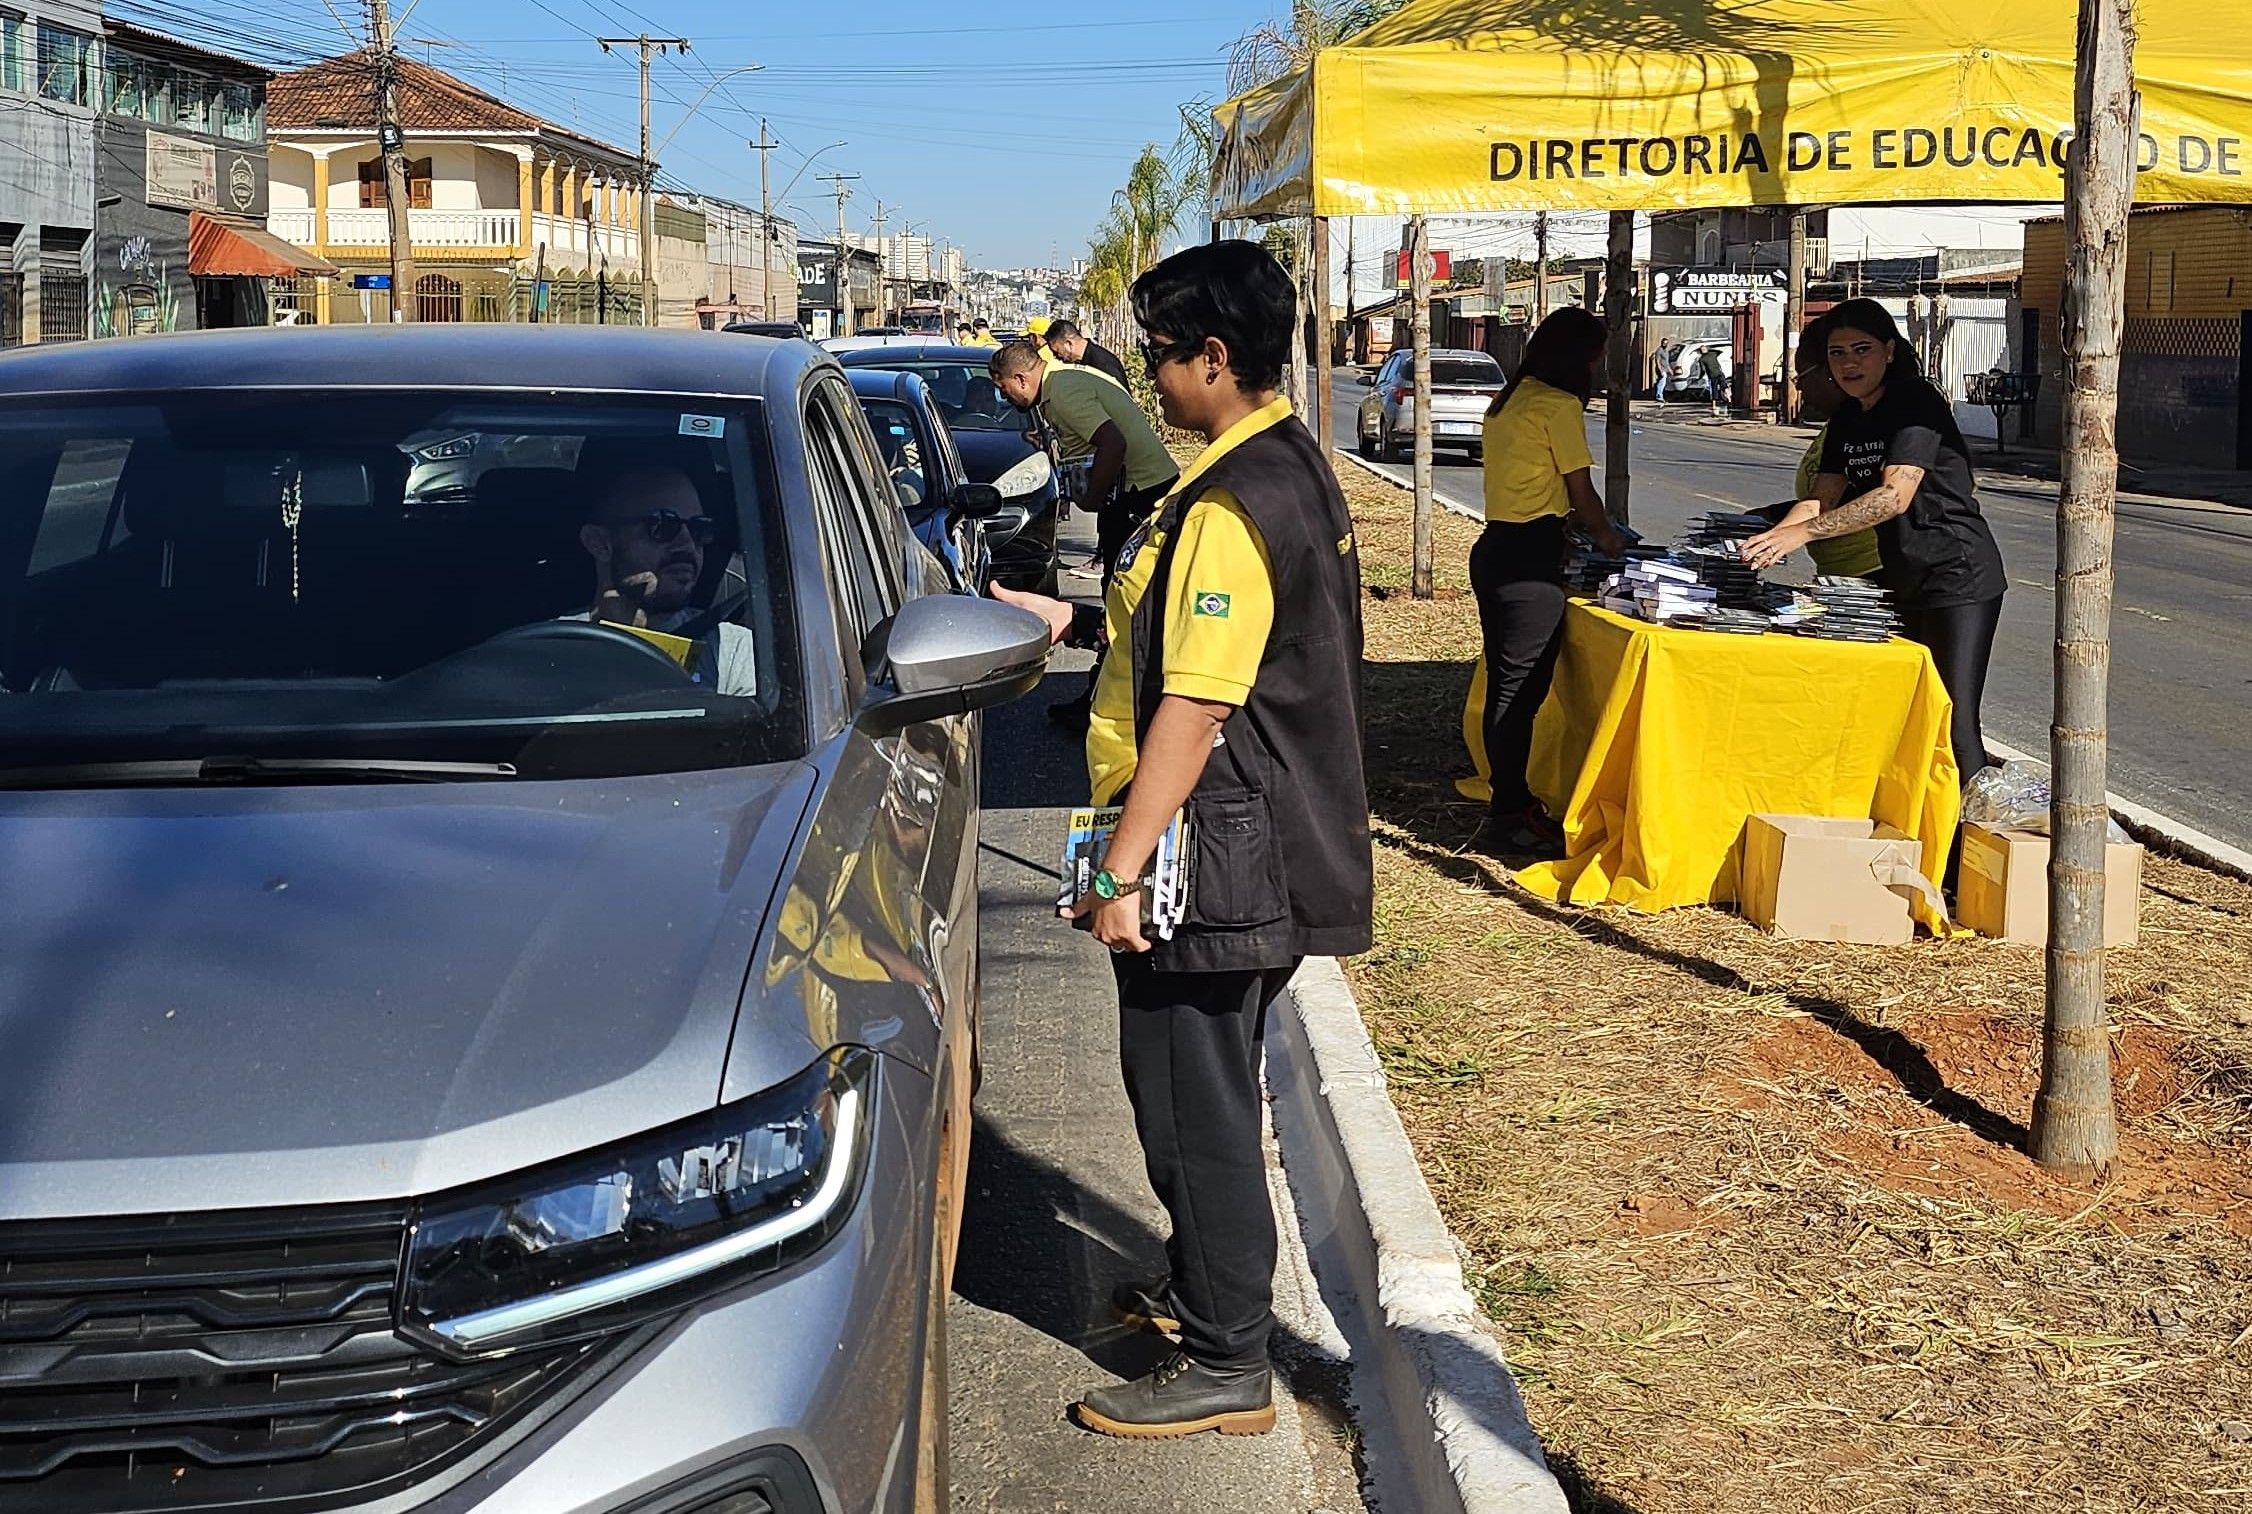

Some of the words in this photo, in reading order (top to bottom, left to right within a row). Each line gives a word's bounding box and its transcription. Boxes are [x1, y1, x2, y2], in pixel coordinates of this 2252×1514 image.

[1489, 132, 1769, 182] DIRETORIA
[1787, 130, 1852, 172] DE
[1872, 126, 2159, 179] EDUCAÇO
[2178, 135, 2242, 176] DE
[797, 262, 826, 285] ADE
[1075, 815, 1090, 828] EU
[1092, 812, 1121, 827] RESP
